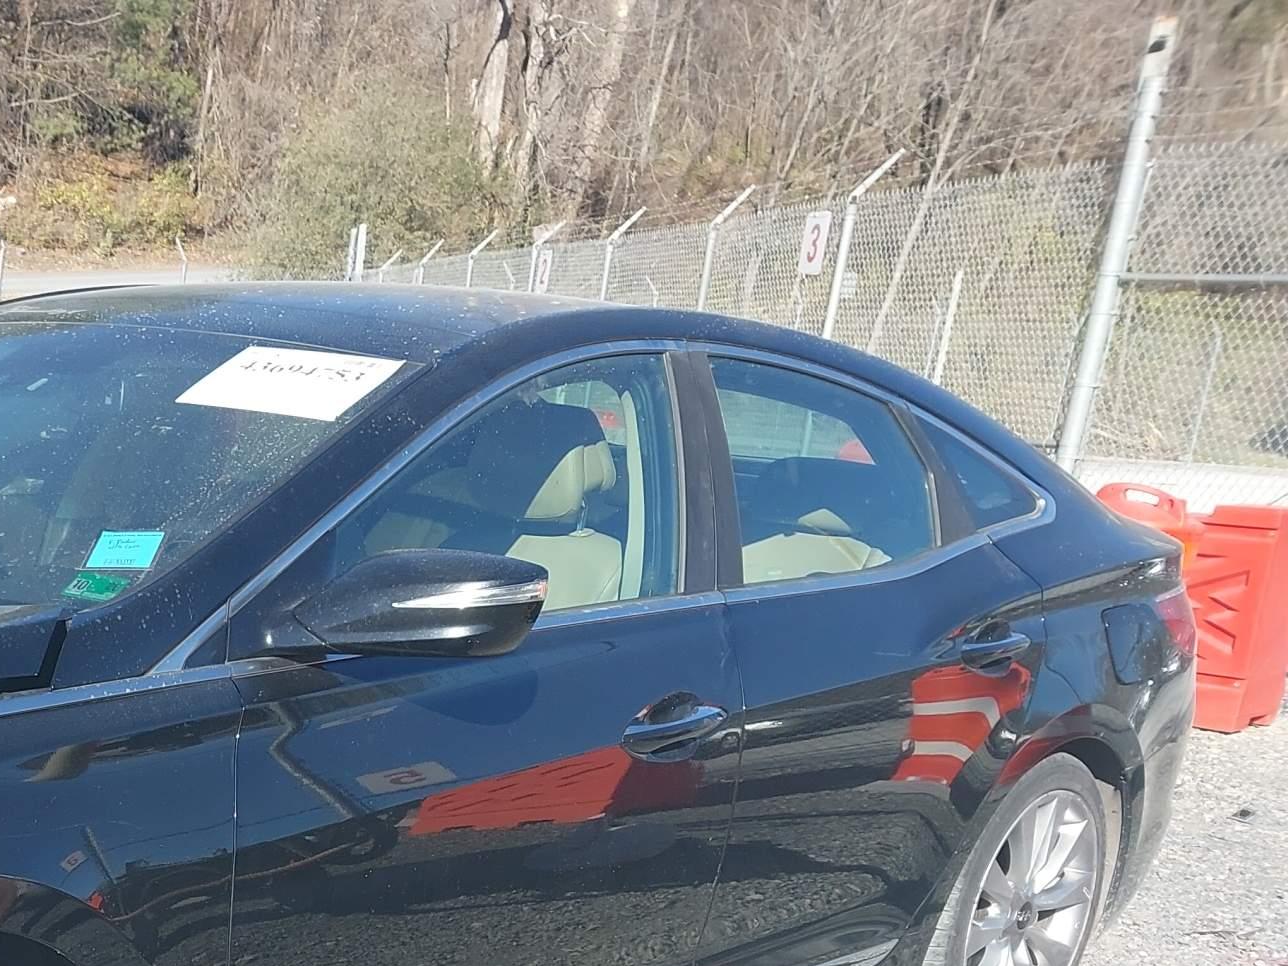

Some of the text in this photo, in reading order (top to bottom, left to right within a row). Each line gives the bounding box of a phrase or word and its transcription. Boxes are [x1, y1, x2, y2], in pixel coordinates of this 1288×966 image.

[807, 223, 821, 264] 3
[539, 258, 548, 285] 2
[72, 579, 89, 591] 10
